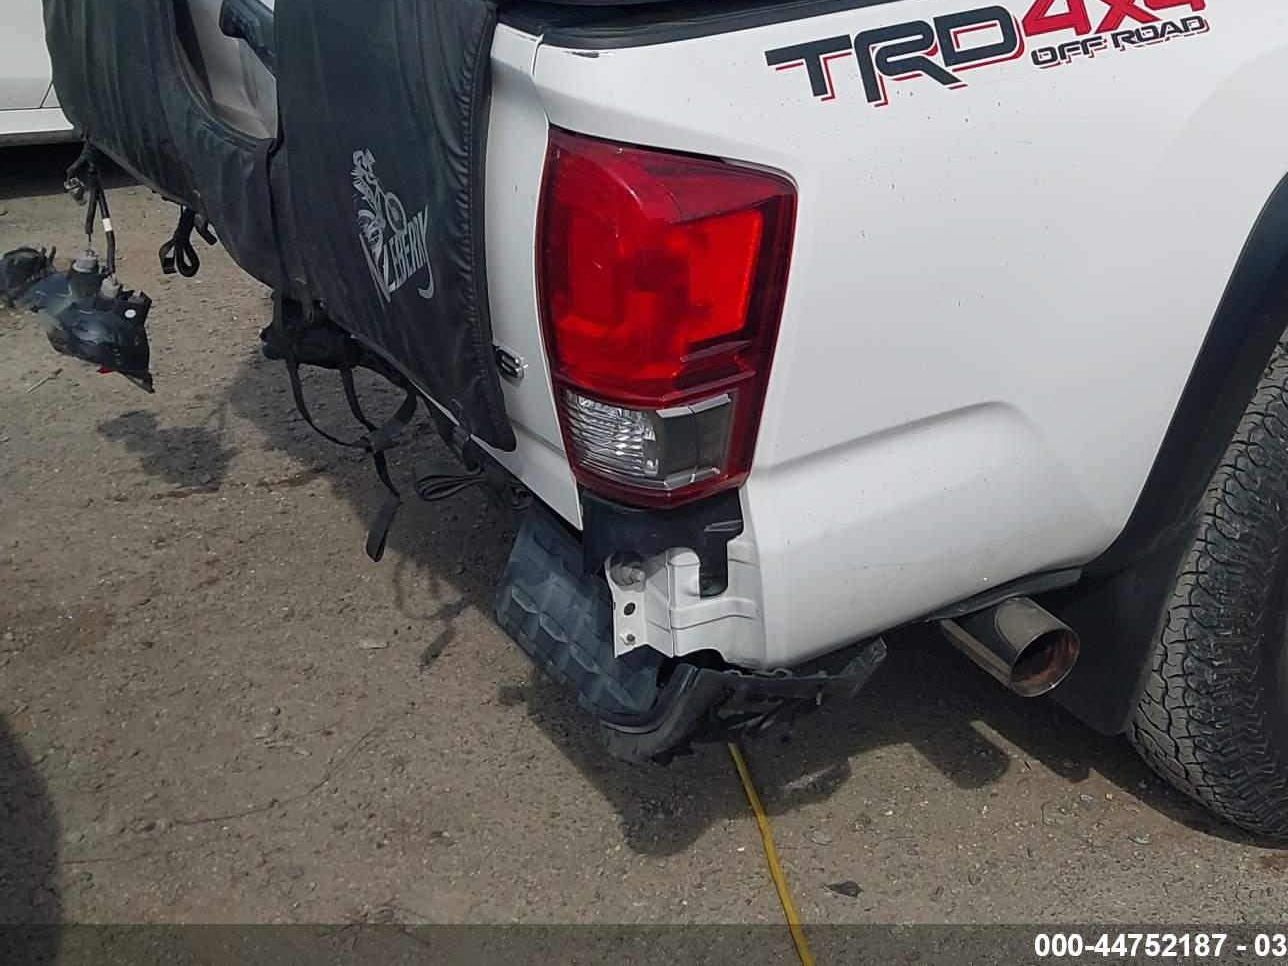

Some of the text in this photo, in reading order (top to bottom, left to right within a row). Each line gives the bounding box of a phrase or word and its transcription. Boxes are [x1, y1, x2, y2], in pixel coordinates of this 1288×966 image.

[764, 5, 1024, 106] TRD
[1031, 14, 1210, 69] OFF ROAD
